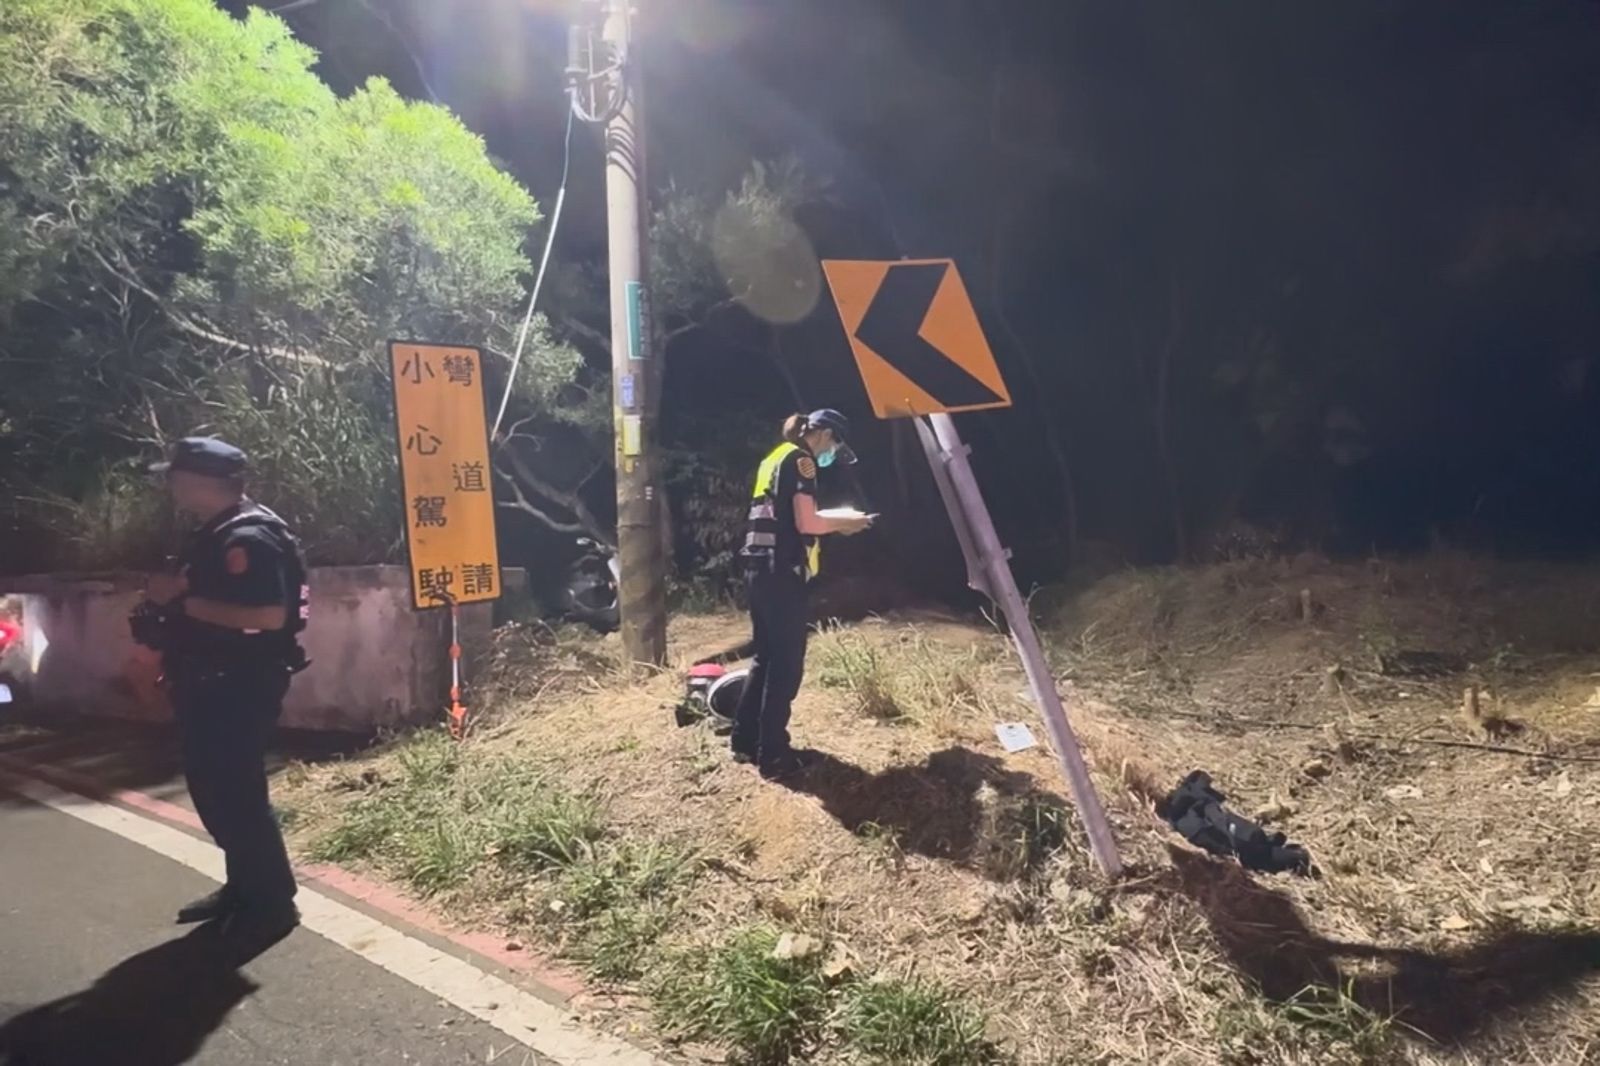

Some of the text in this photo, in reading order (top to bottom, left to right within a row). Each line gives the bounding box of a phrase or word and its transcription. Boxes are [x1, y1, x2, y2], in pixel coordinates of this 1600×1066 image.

[400, 352, 457, 599] 小心駕駛
[443, 355, 493, 595] 彎道請
